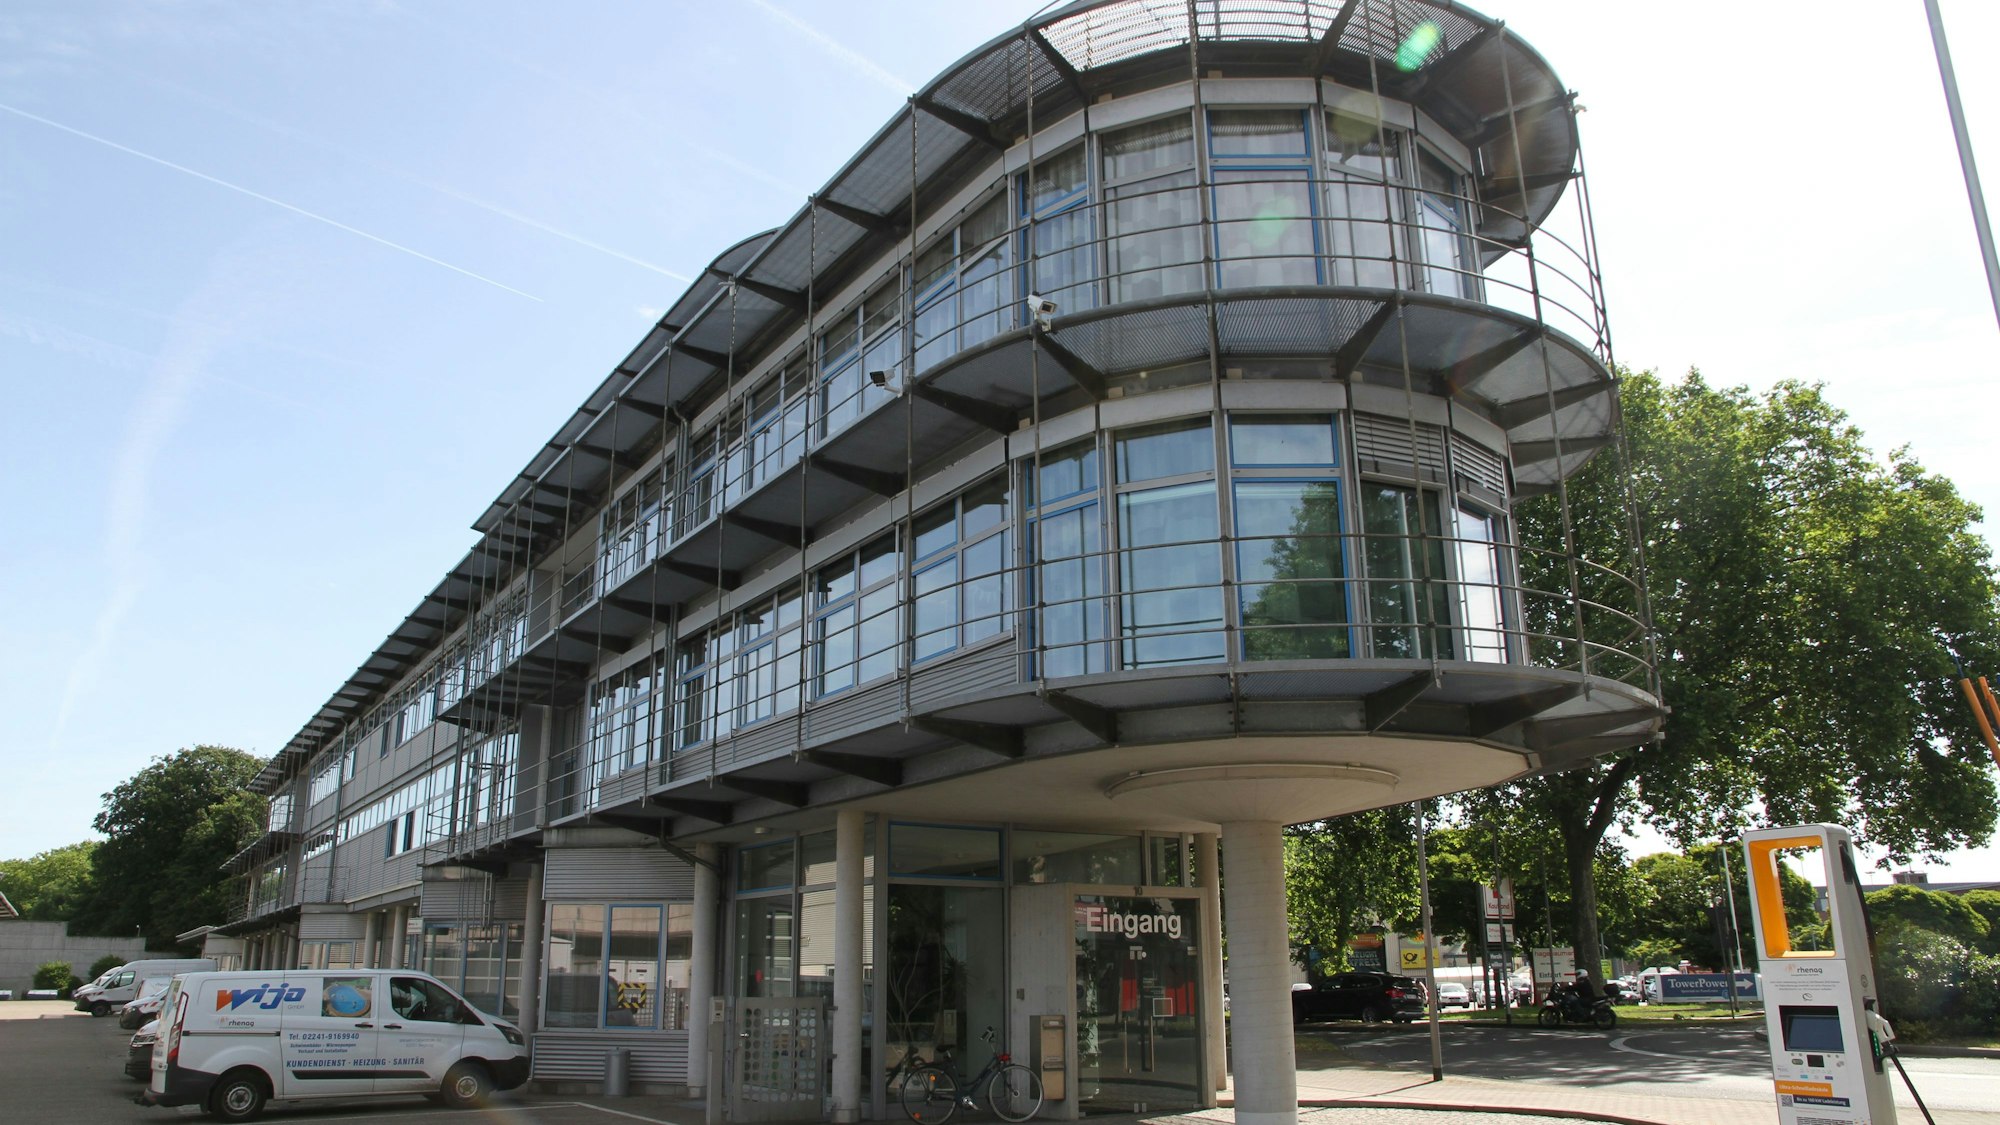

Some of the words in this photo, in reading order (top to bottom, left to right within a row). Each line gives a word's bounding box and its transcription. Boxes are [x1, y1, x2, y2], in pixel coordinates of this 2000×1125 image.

[1086, 907, 1181, 939] Eingang
[1667, 978, 1729, 988] TowerPower
[286, 1060, 346, 1068] KUNDENDIENST
[353, 1058, 387, 1067] HEIZUNG
[393, 1056, 425, 1066] SANITÄR
